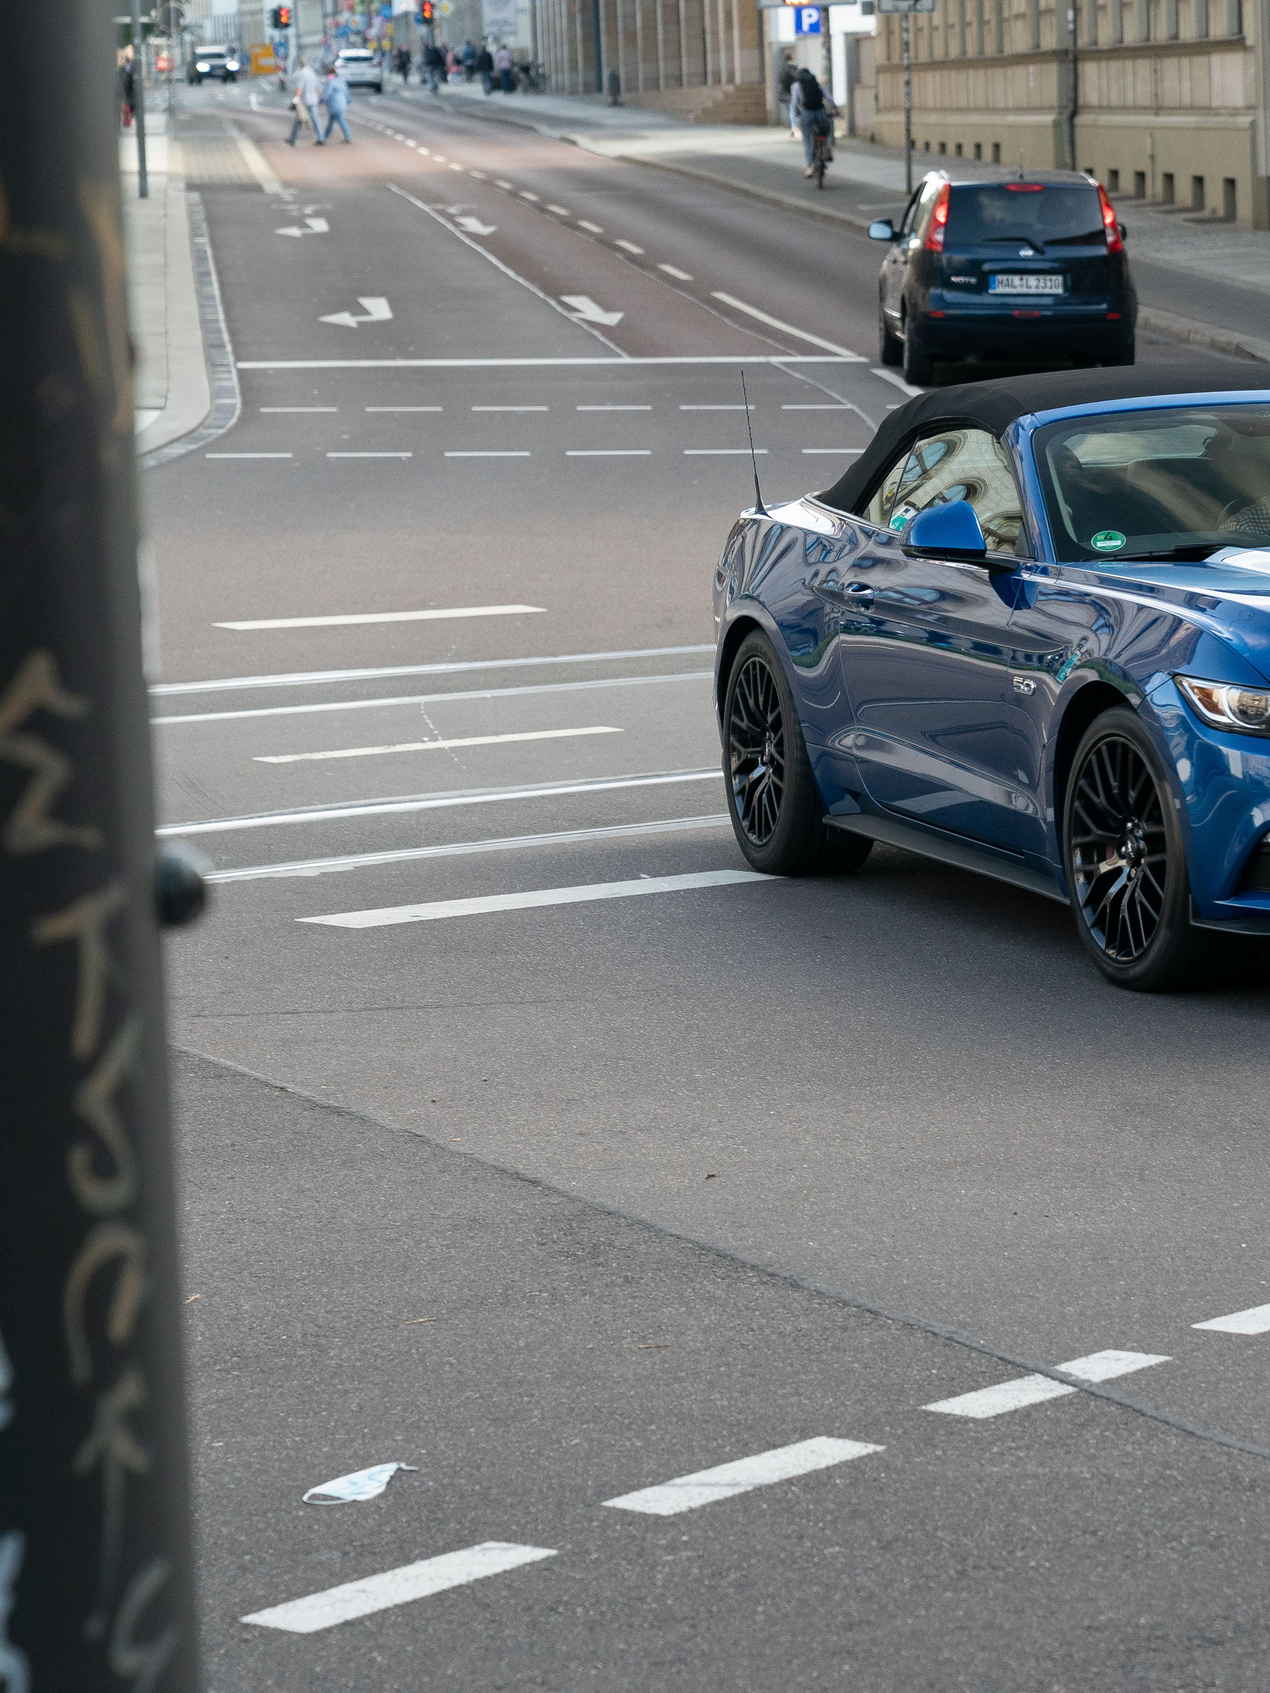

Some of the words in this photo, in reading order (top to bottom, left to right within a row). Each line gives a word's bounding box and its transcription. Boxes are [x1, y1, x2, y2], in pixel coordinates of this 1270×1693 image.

[801, 8, 819, 32] P
[997, 277, 1017, 290] HAL
[1104, 531, 1114, 541] 4
